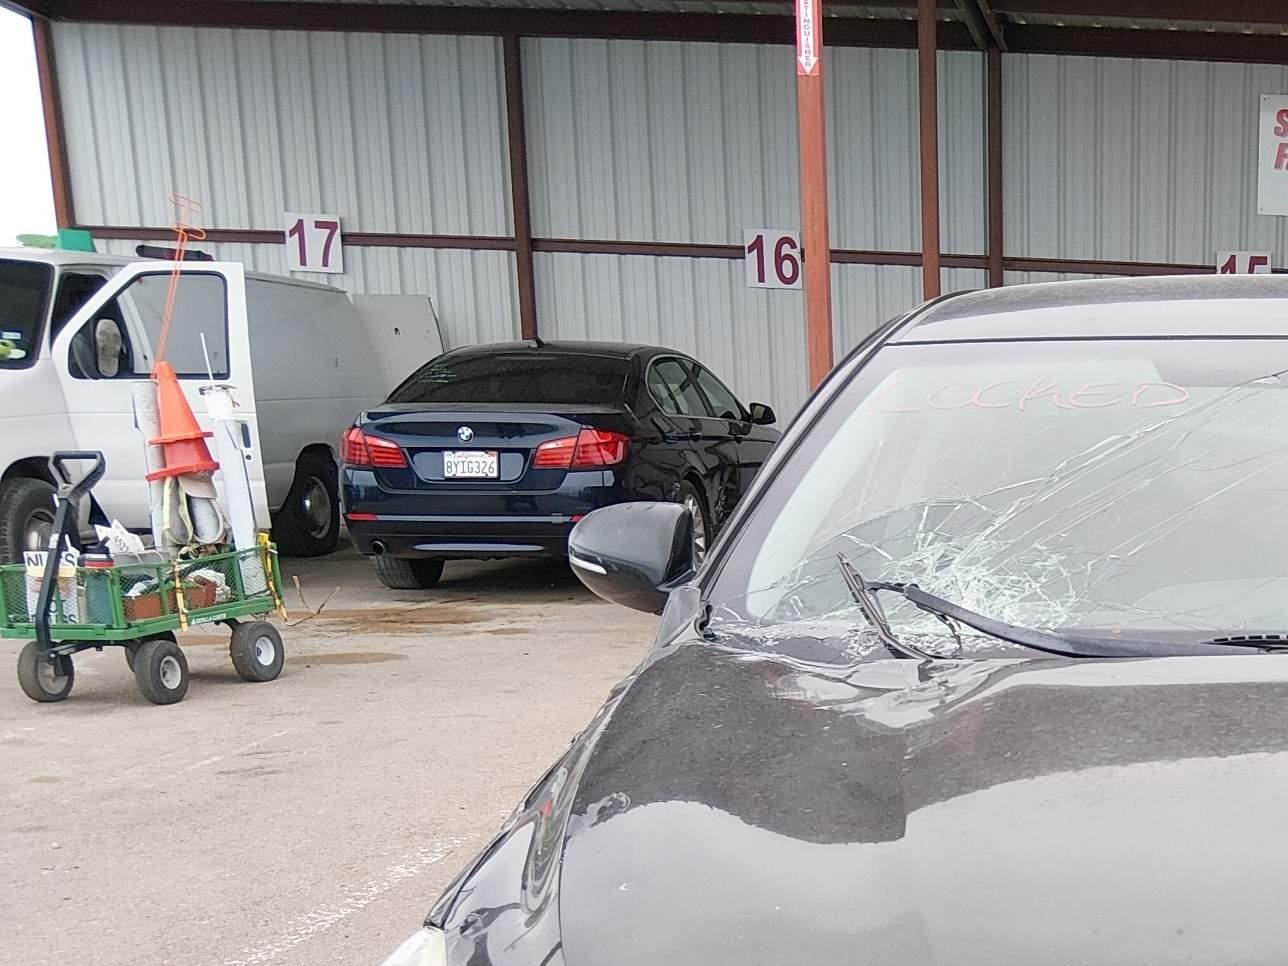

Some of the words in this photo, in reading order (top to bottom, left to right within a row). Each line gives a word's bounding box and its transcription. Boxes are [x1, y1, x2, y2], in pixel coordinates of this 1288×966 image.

[289, 219, 338, 267] 17
[747, 234, 800, 285] 16
[446, 460, 495, 474] 8YIG326
